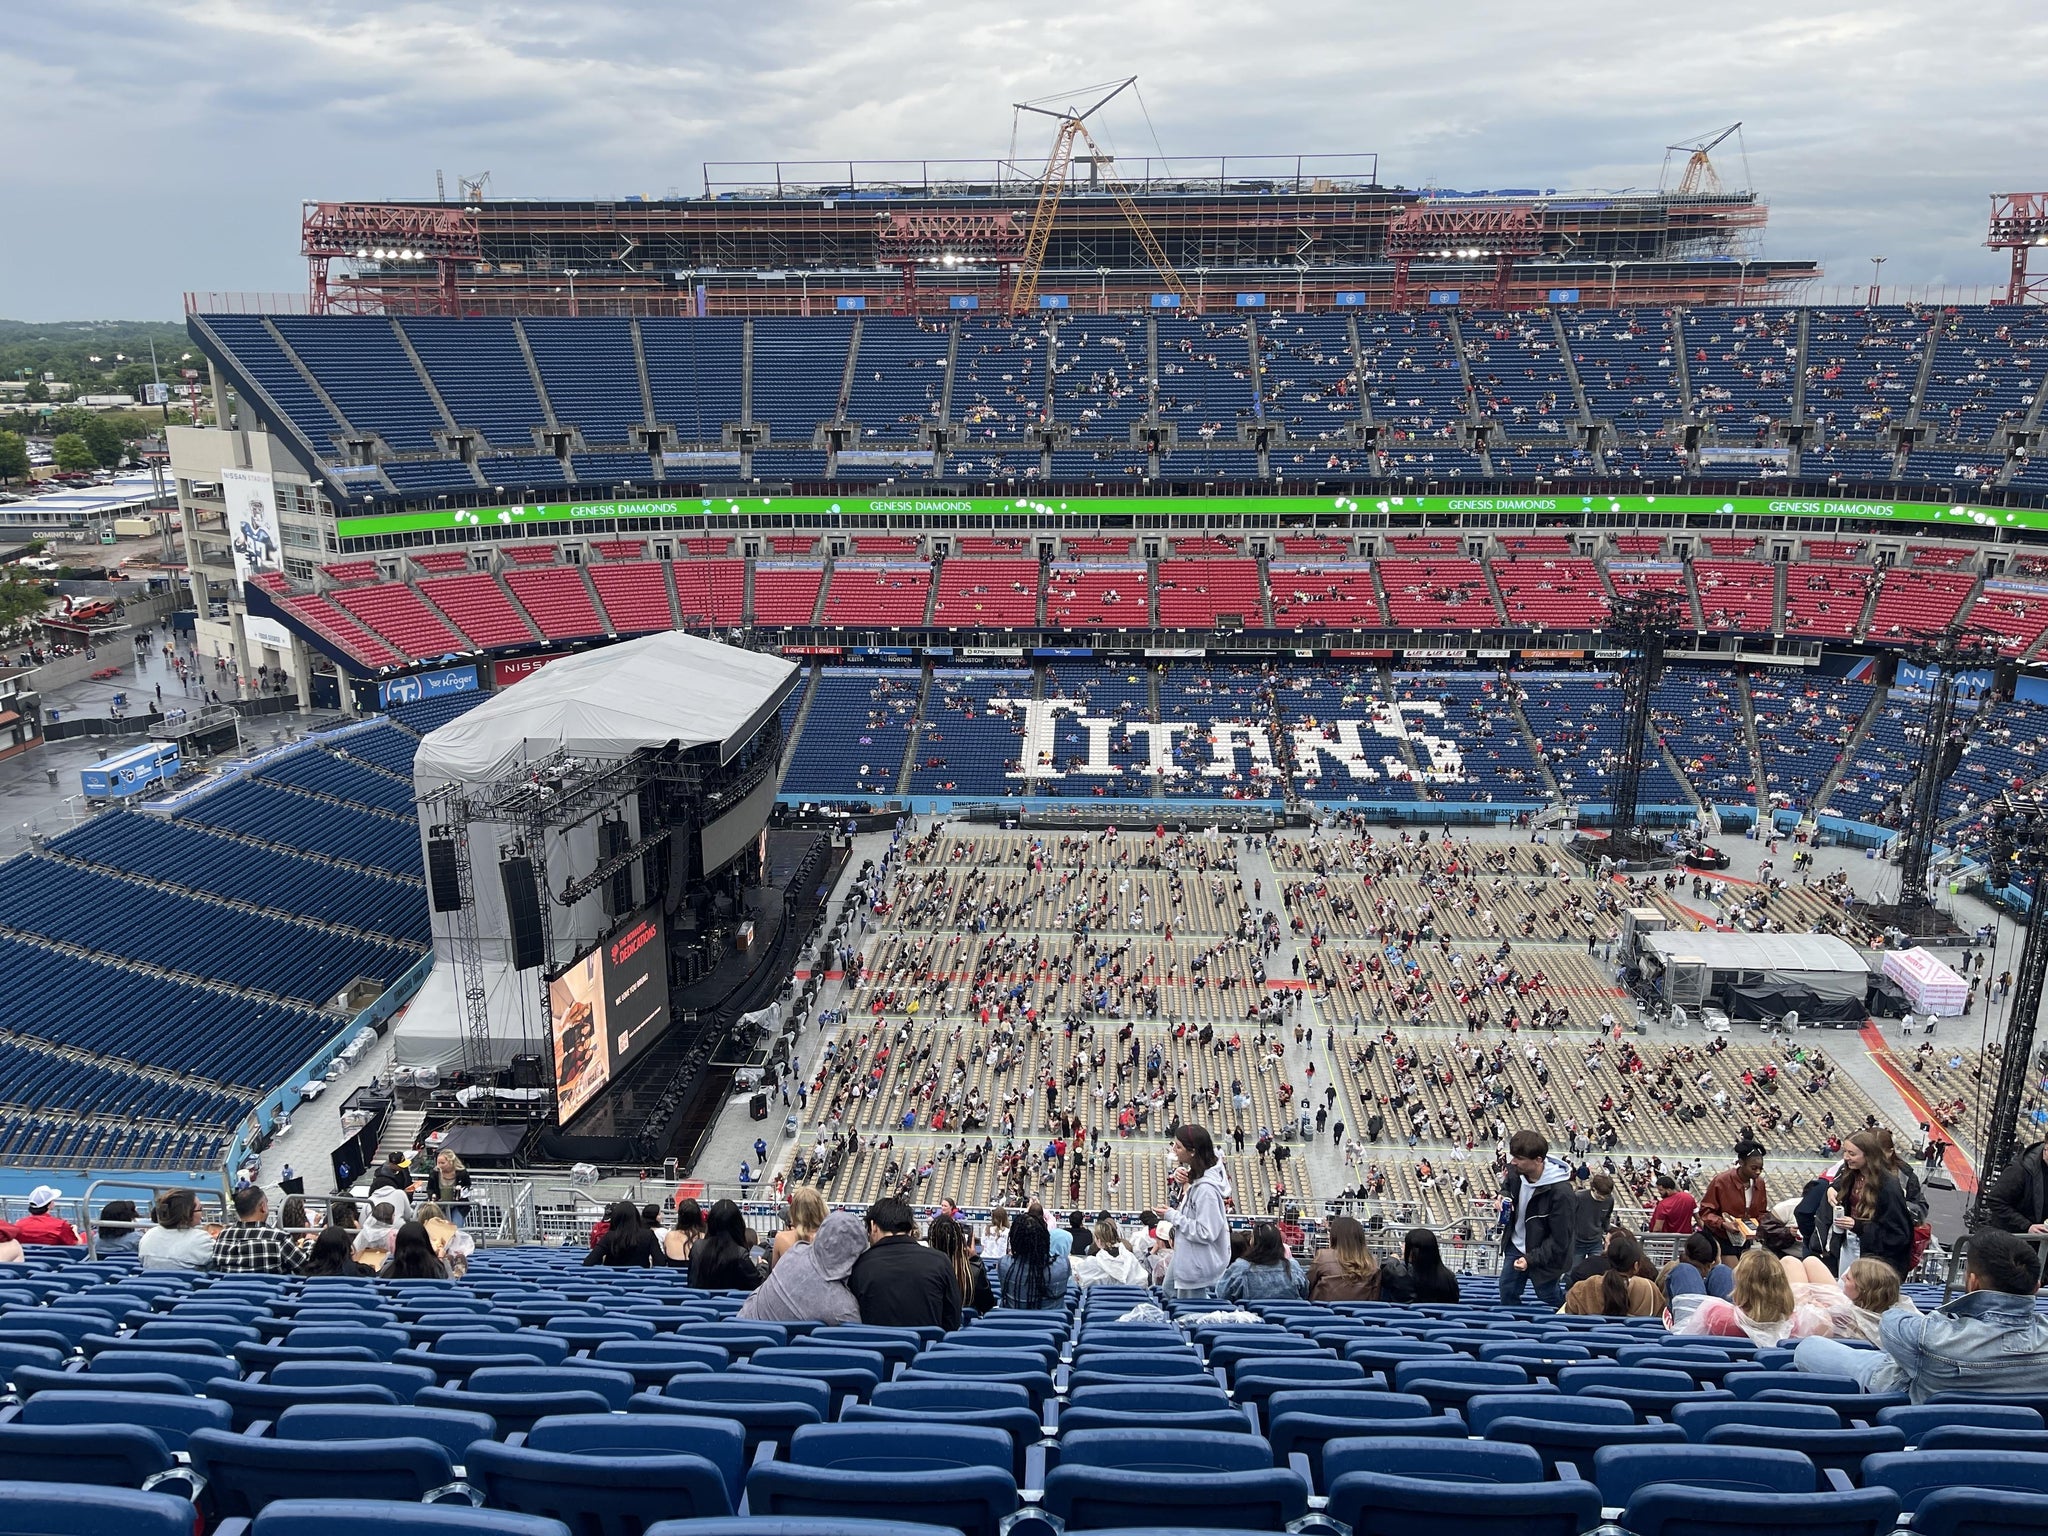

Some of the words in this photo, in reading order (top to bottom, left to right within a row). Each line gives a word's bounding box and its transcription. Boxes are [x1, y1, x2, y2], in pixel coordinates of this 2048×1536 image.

[570, 504, 615, 516] GENESIS
[618, 503, 677, 514] DIAMONDS
[870, 501, 912, 511] GENESIS
[915, 501, 972, 511] DIAMONDS
[1448, 499, 1493, 510] GENESIS
[1496, 499, 1556, 510] DIAMONDS
[1768, 502, 1820, 512] GENESIS
[1824, 503, 1893, 516] DIAMONDS
[32, 531, 65, 539] COMING
[505, 660, 551, 673] NISS
[1766, 666, 1805, 674] TITANS
[442, 673, 473, 690] Kroger
[986, 697, 1466, 783] TITANS
[1350, 807, 1378, 816] ENNESSEE
[620, 923, 656, 963] DEDICATIONS
